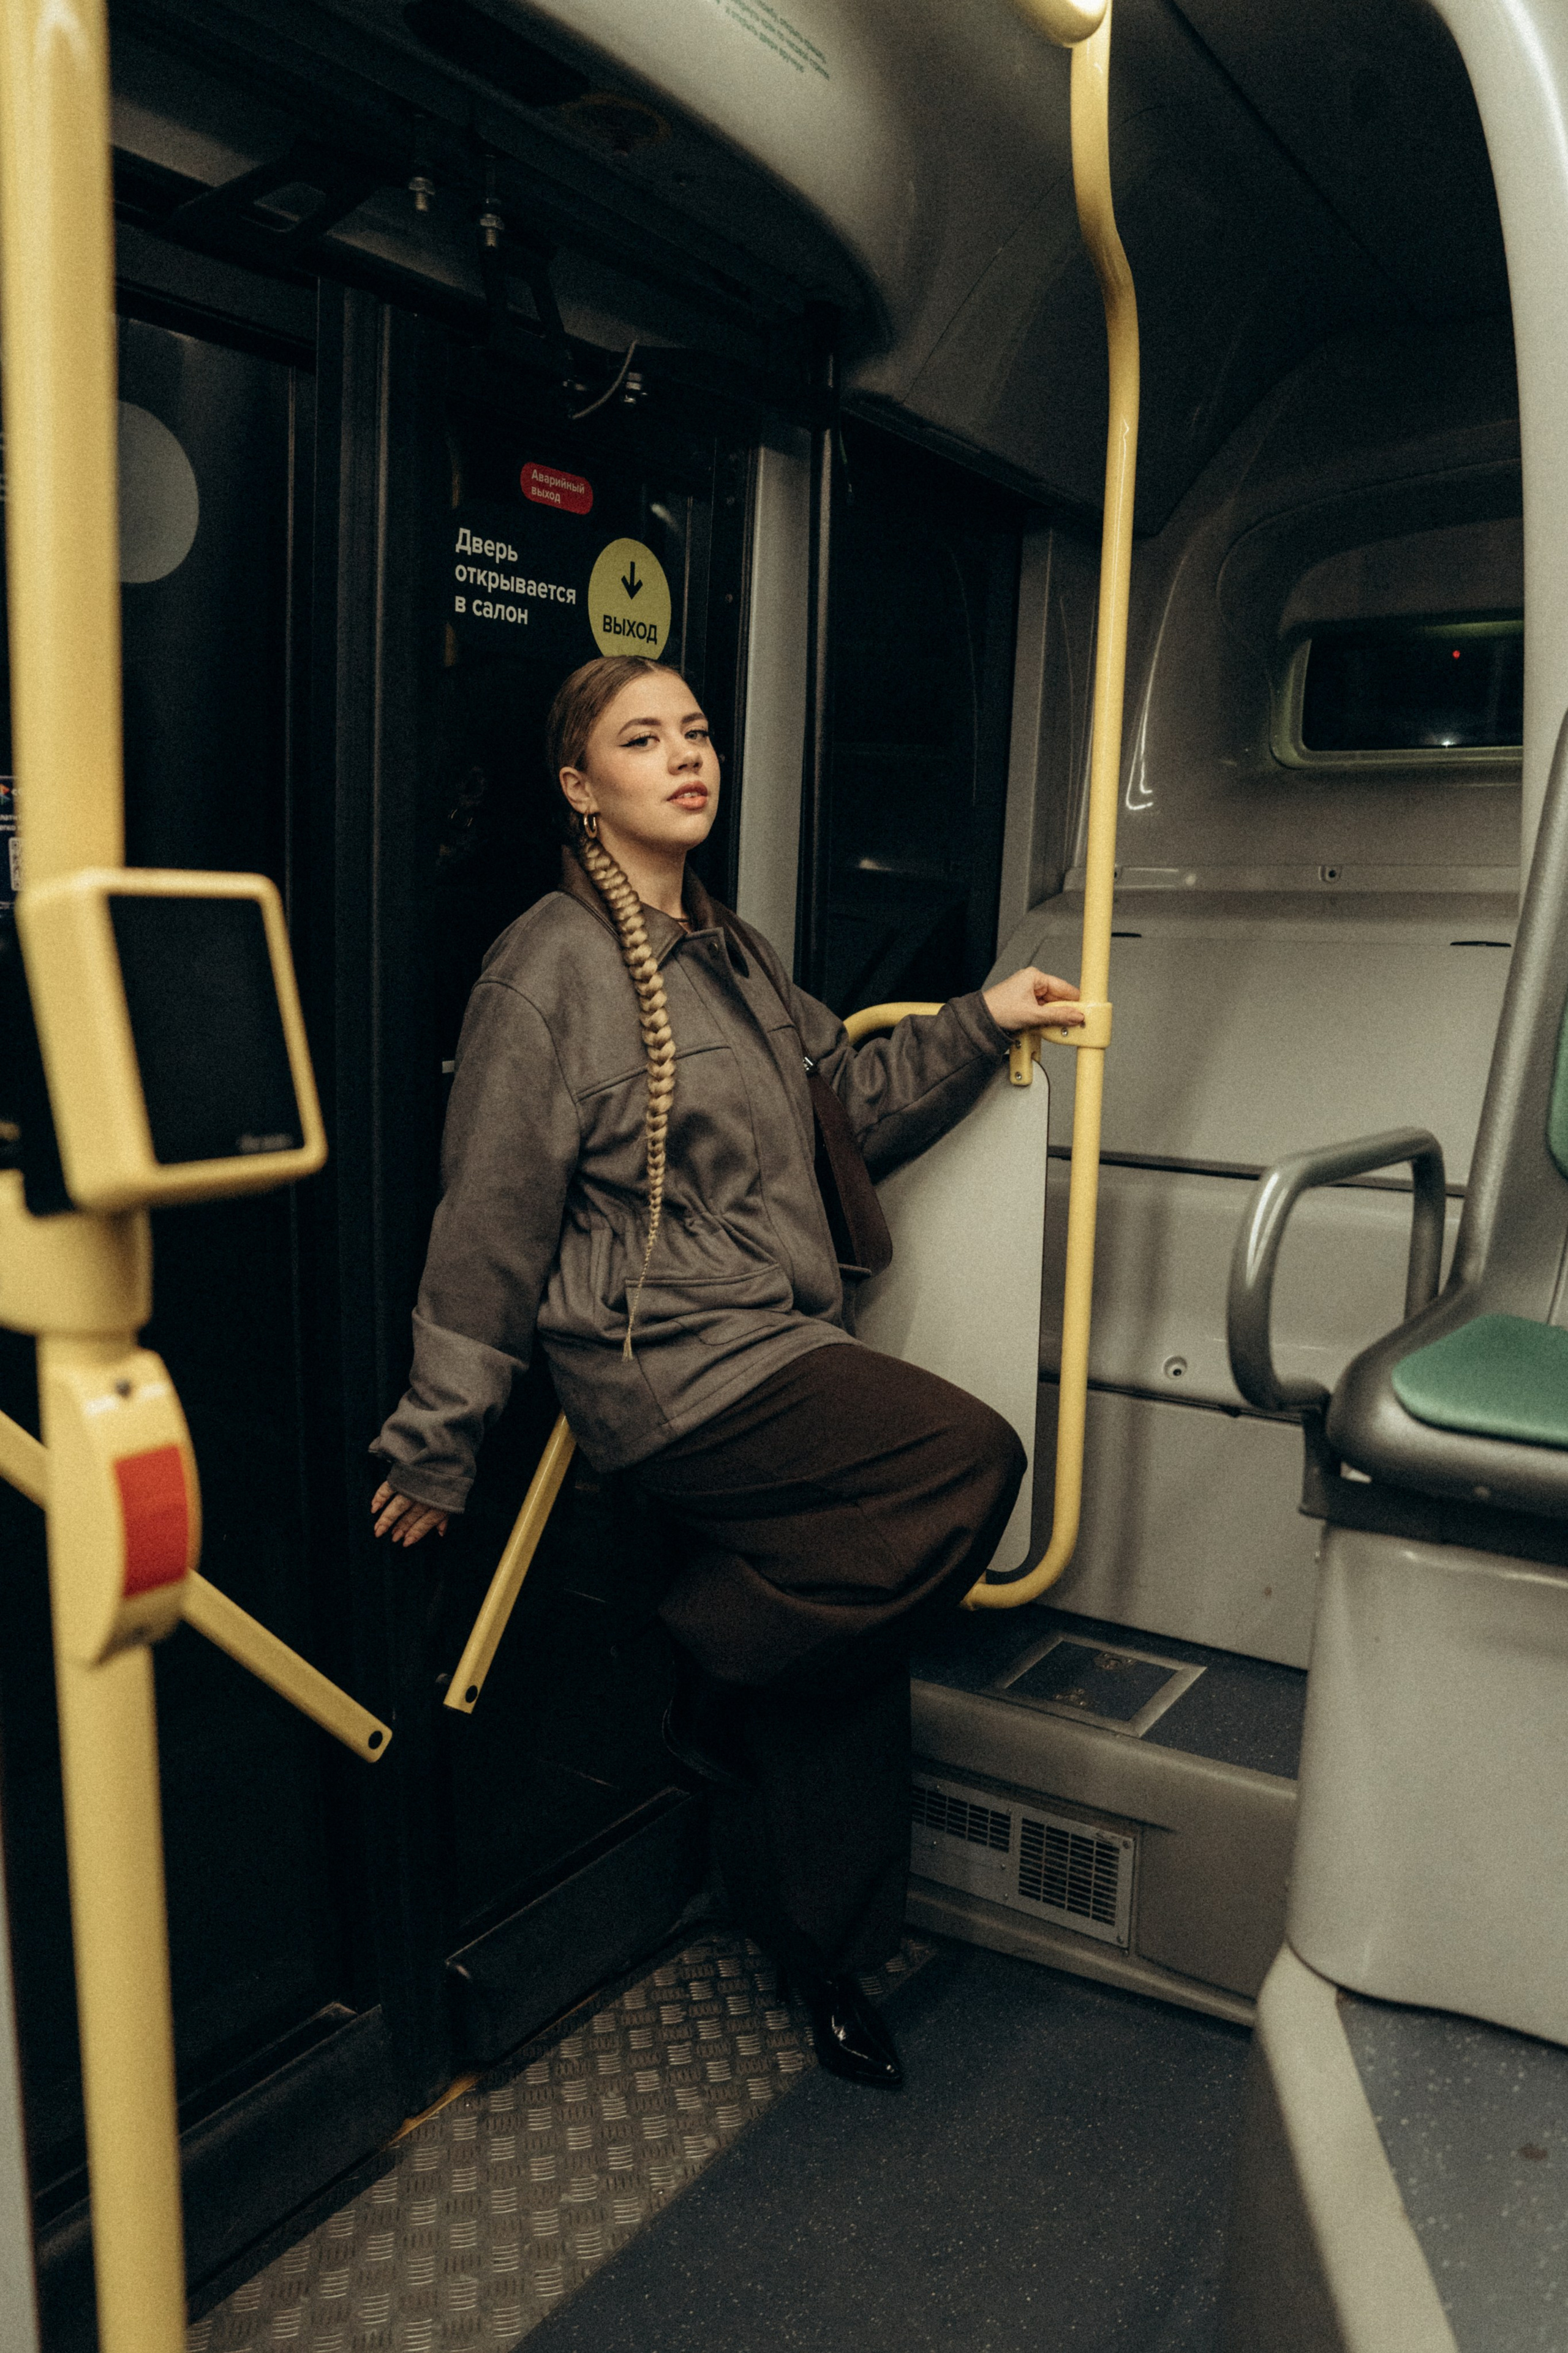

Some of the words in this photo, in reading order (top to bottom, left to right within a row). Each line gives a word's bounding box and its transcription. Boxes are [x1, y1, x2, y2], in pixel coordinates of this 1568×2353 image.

[531, 469, 585, 494] Аварийный
[531, 486, 561, 504] выход
[456, 527, 518, 564] Дверь
[455, 565, 576, 605] открывается
[455, 595, 466, 613] в
[472, 599, 528, 624] салон
[603, 614, 657, 645] ВЫХОД
